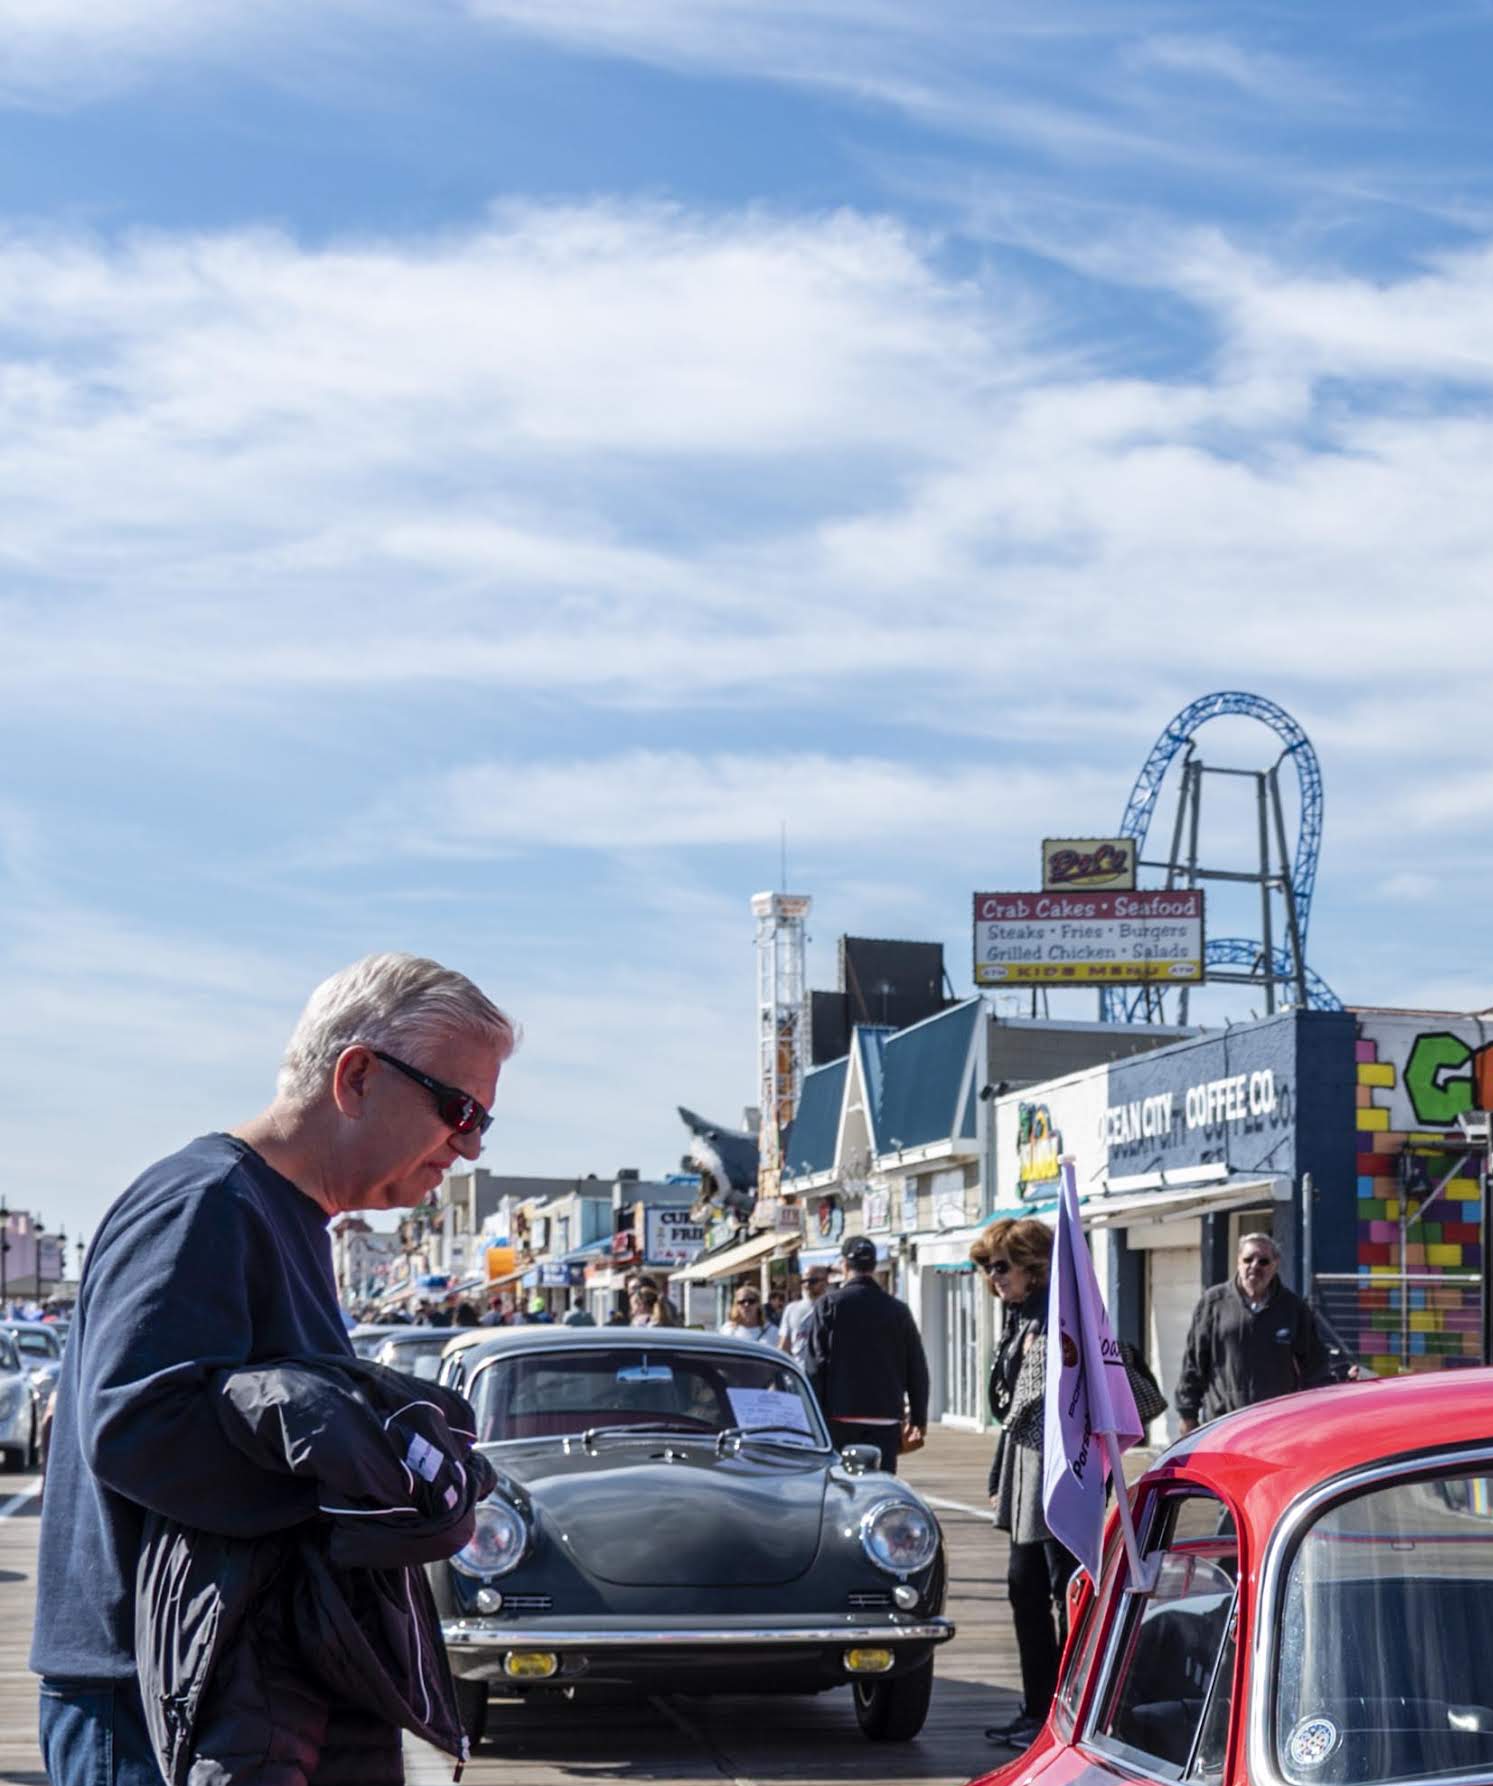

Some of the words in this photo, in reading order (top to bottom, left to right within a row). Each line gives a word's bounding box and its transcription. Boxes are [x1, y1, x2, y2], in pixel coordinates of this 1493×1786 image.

[982, 899, 1029, 918] Crab
[1036, 899, 1096, 917] Cakes
[1115, 896, 1196, 916] Seafood
[988, 925, 1045, 941] Steaks
[1061, 925, 1102, 939] Fries
[1120, 923, 1187, 942] Burgers
[987, 946, 1041, 961] Grilled
[1048, 944, 1116, 961] Chicken
[1132, 943, 1189, 959] Salads
[1017, 967, 1076, 977] KIDS
[1088, 967, 1158, 977] MENU
[1143, 1092, 1173, 1137] CITY
[1186, 1074, 1247, 1129] COFFEE
